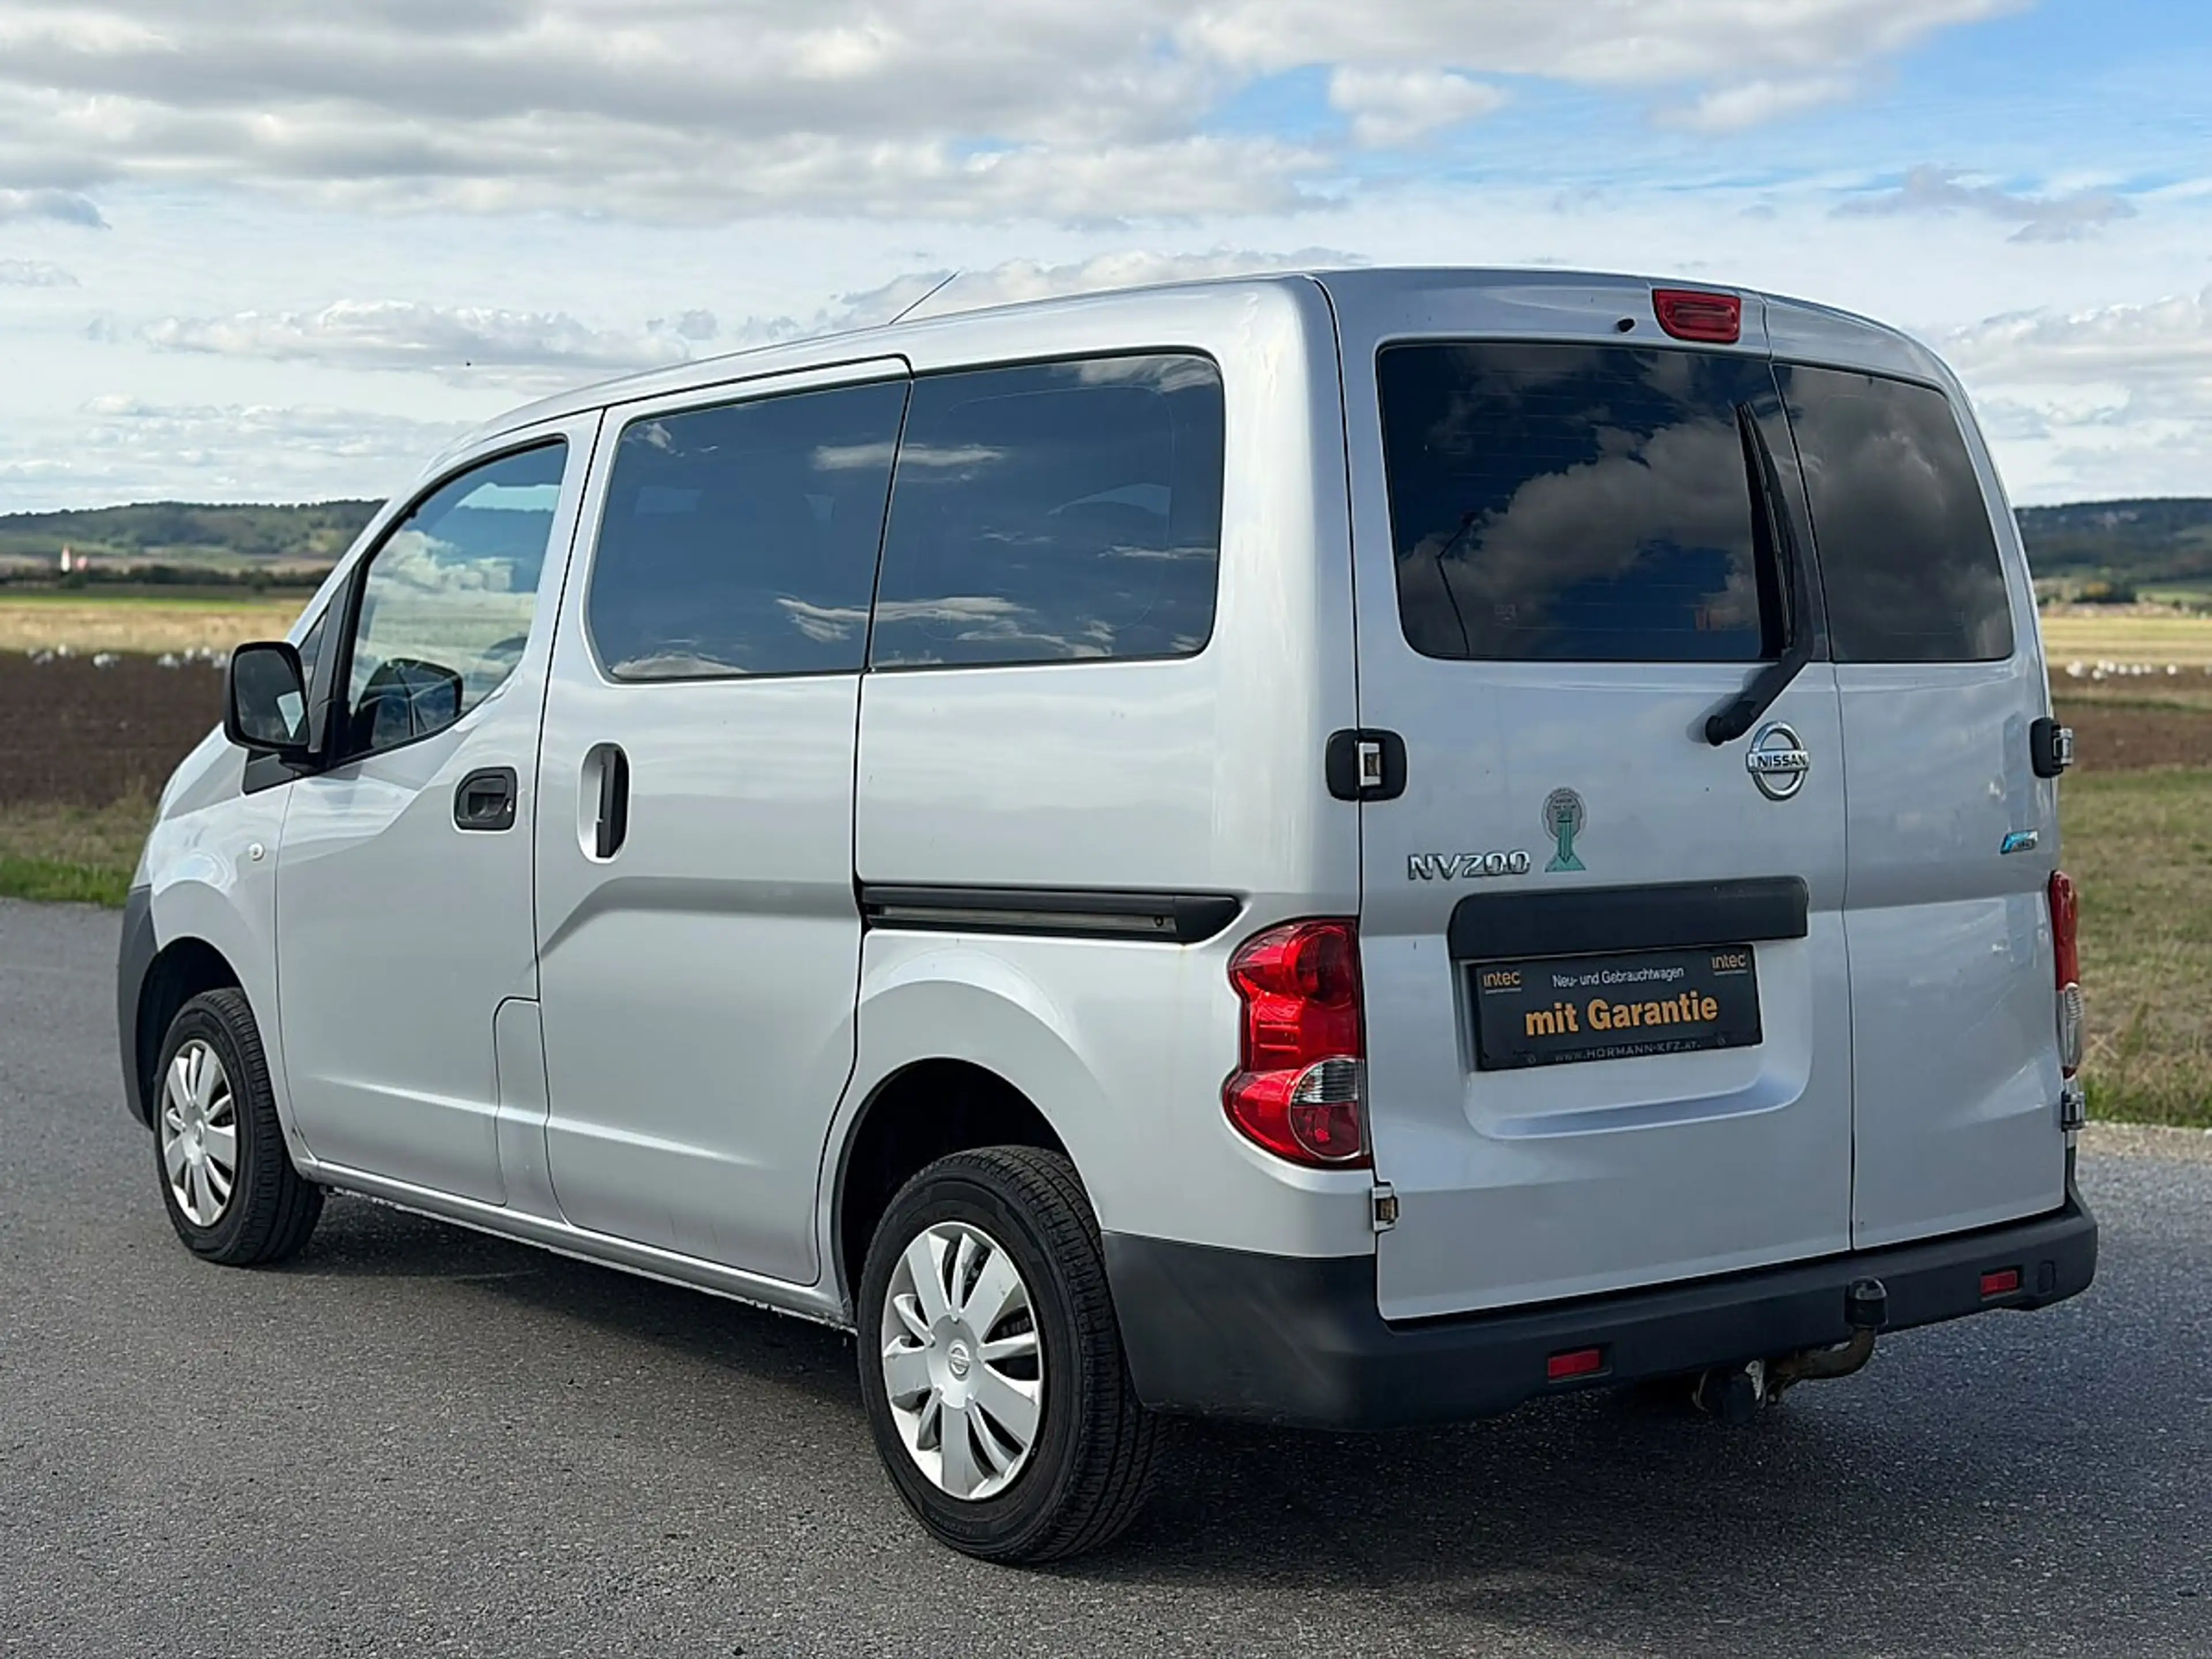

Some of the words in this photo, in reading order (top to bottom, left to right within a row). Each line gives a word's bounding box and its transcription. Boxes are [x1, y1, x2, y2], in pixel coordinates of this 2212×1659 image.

[1756, 753, 1806, 767] NISSAN
[1408, 850, 1531, 880] NV200
[1711, 954, 1747, 969] intec
[1483, 971, 1522, 987] intec
[1552, 974, 1578, 987] Neu-
[1580, 972, 1599, 986] und
[1601, 967, 1684, 983] Gebrauchtwagen
[1526, 1002, 1579, 1036] mit
[1588, 990, 1718, 1030] Garantie
